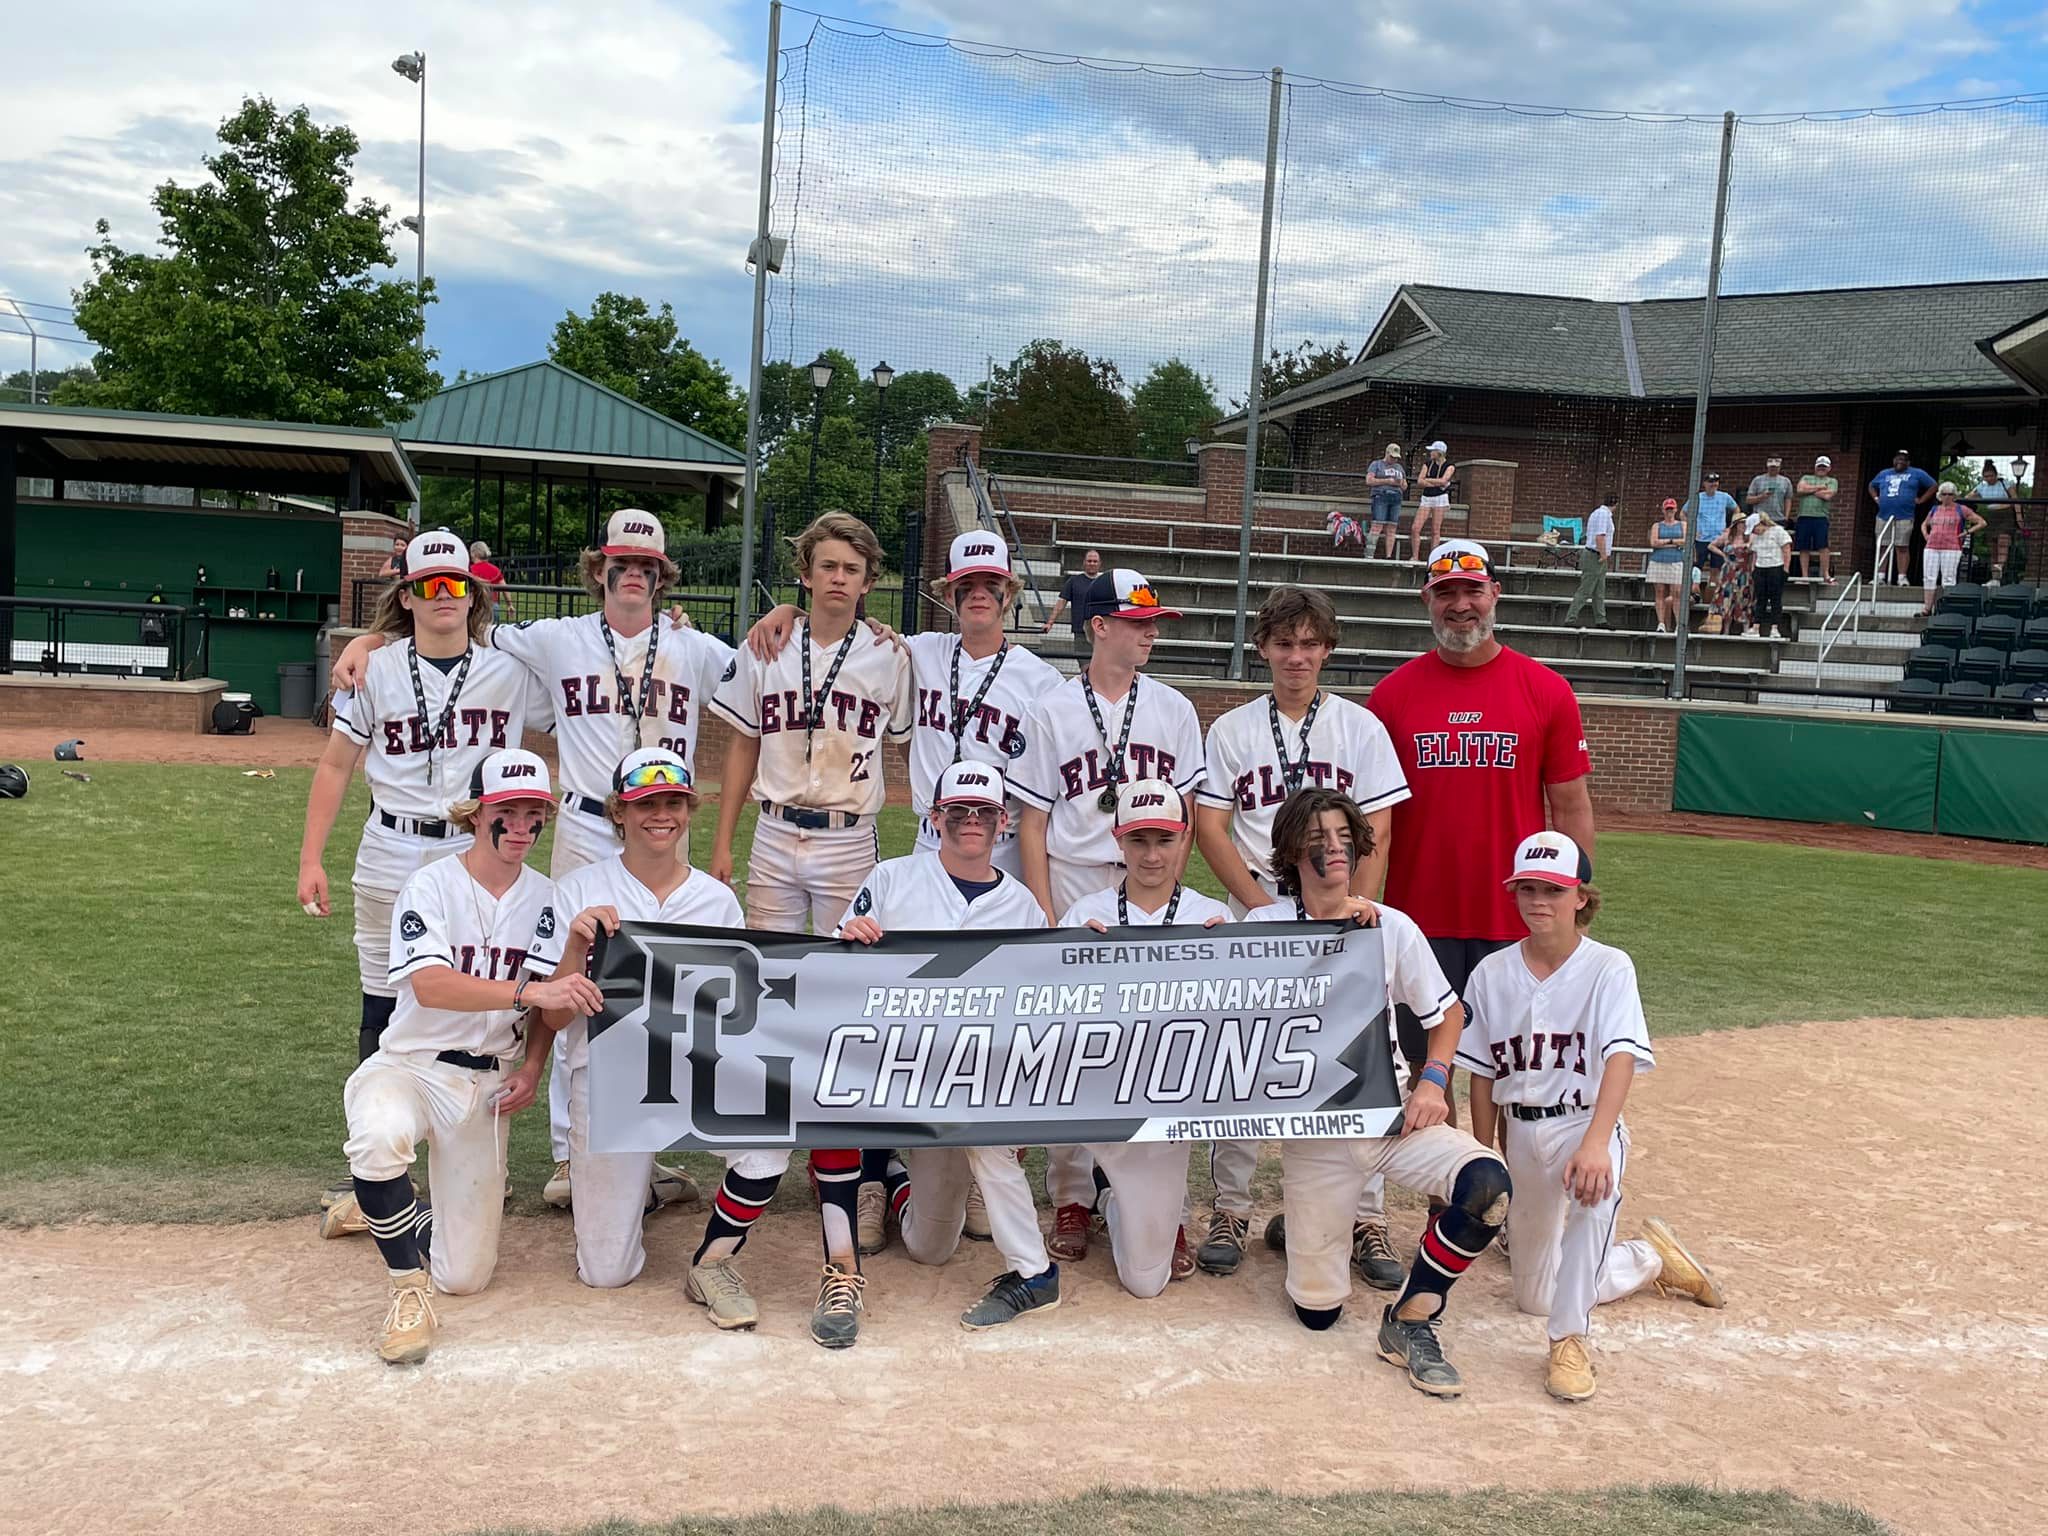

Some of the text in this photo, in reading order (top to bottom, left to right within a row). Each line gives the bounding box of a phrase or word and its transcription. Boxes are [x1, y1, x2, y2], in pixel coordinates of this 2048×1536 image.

[622, 521, 655, 537] WR
[422, 542, 456, 556] WR
[963, 543, 996, 558] WR
[1448, 711, 1483, 724] WR
[1413, 731, 1519, 769] ELITE
[501, 764, 537, 779] WR
[955, 772, 990, 788] WR
[1130, 793, 1166, 809] WR
[1524, 846, 1560, 860] WR
[1061, 943, 1219, 965] GREATNESS.
[862, 974, 1333, 1018] PERFECT GAME TOURNAMENT
[813, 1015, 1322, 1109] CHAMPIONS
[1165, 1113, 1366, 1139] #PGTOURNEY CHAMPS
